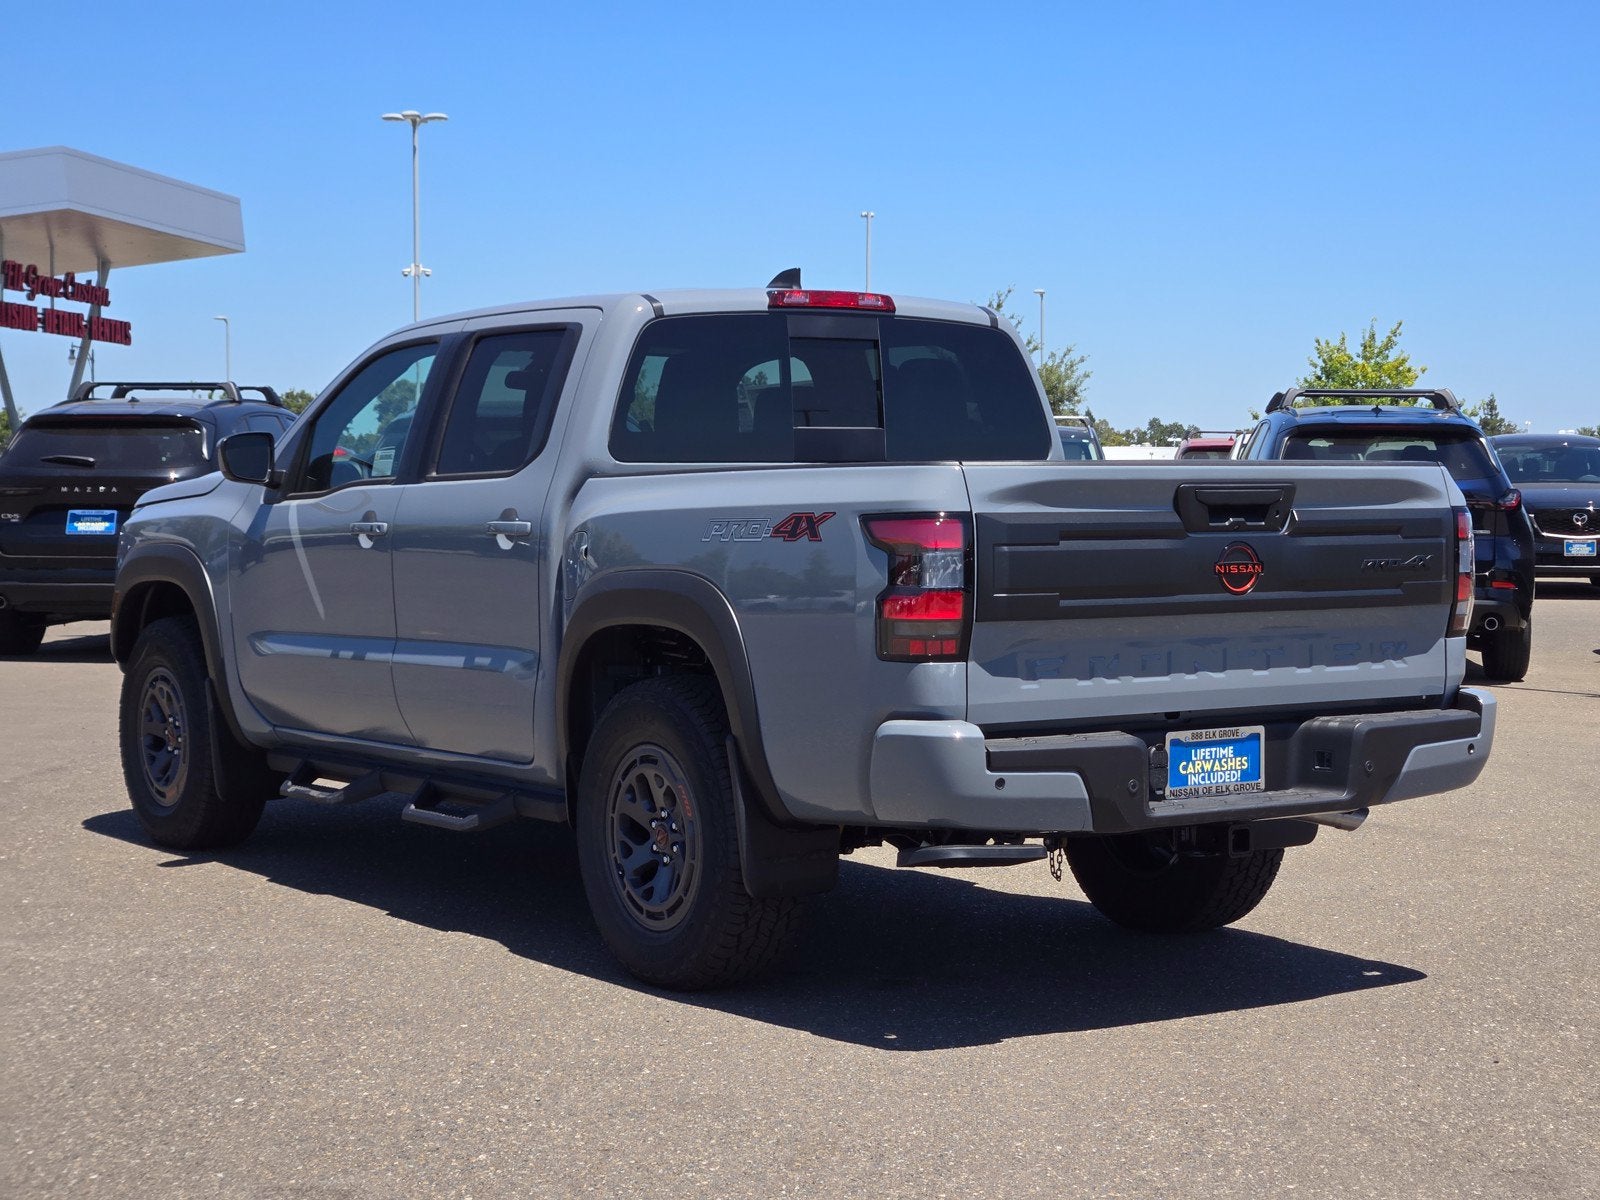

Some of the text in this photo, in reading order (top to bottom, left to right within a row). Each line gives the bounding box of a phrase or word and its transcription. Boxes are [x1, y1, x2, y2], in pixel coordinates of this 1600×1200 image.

[89, 316, 131, 346] RENTALS
[1215, 563, 1262, 573] NISSAN
[1191, 729, 1240, 740] 888 ELK GROVE
[1191, 746, 1234, 760] LIFETIME
[1179, 757, 1248, 774] CARWASHES
[1188, 770, 1241, 785] INCLUDED!
[1169, 782, 1261, 797] NISSAN OF ELK GROVE
